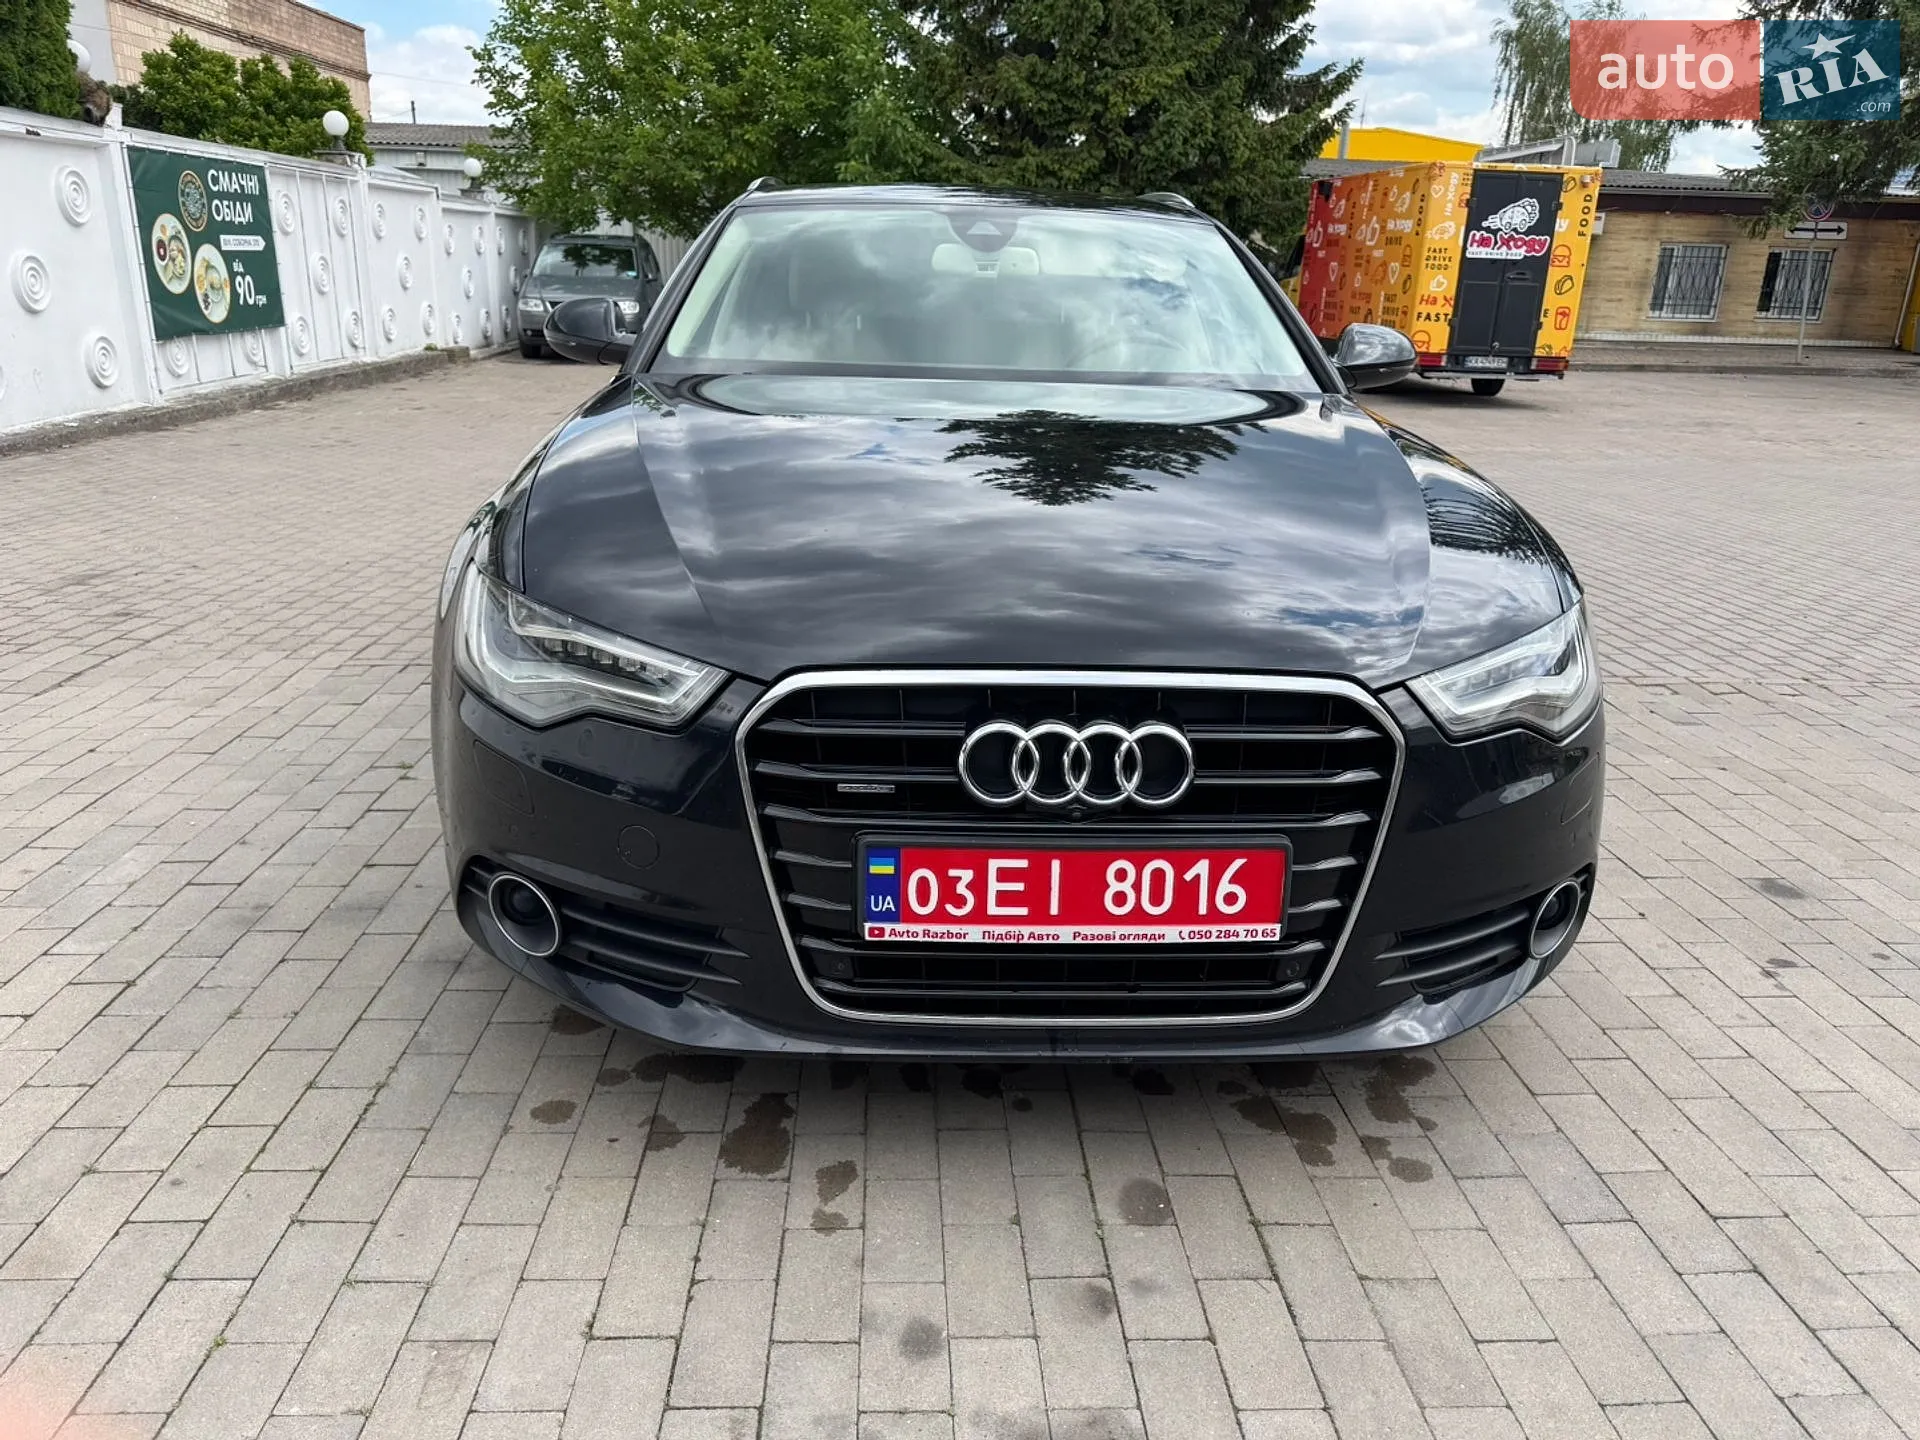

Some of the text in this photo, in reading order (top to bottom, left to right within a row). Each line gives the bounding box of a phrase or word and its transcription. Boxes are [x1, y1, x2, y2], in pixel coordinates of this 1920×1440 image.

[207, 169, 259, 195] СМАЧНІ
[211, 199, 254, 225] ОБІДИ
[1577, 194, 1593, 237] FOOD
[1427, 246, 1449, 255] FAST
[1425, 254, 1453, 263] DRIVE
[1425, 262, 1450, 271] FOOD
[235, 274, 255, 305] 90
[1416, 311, 1450, 323] FAST
[907, 858, 1249, 917] 03EI 8016
[870, 894, 896, 912] UA
[888, 927, 969, 940] Avto Razbor
[981, 929, 1060, 943] Підбір Авто
[1072, 930, 1166, 943] Разові огляди
[1188, 928, 1277, 940] 050 284 70 65
